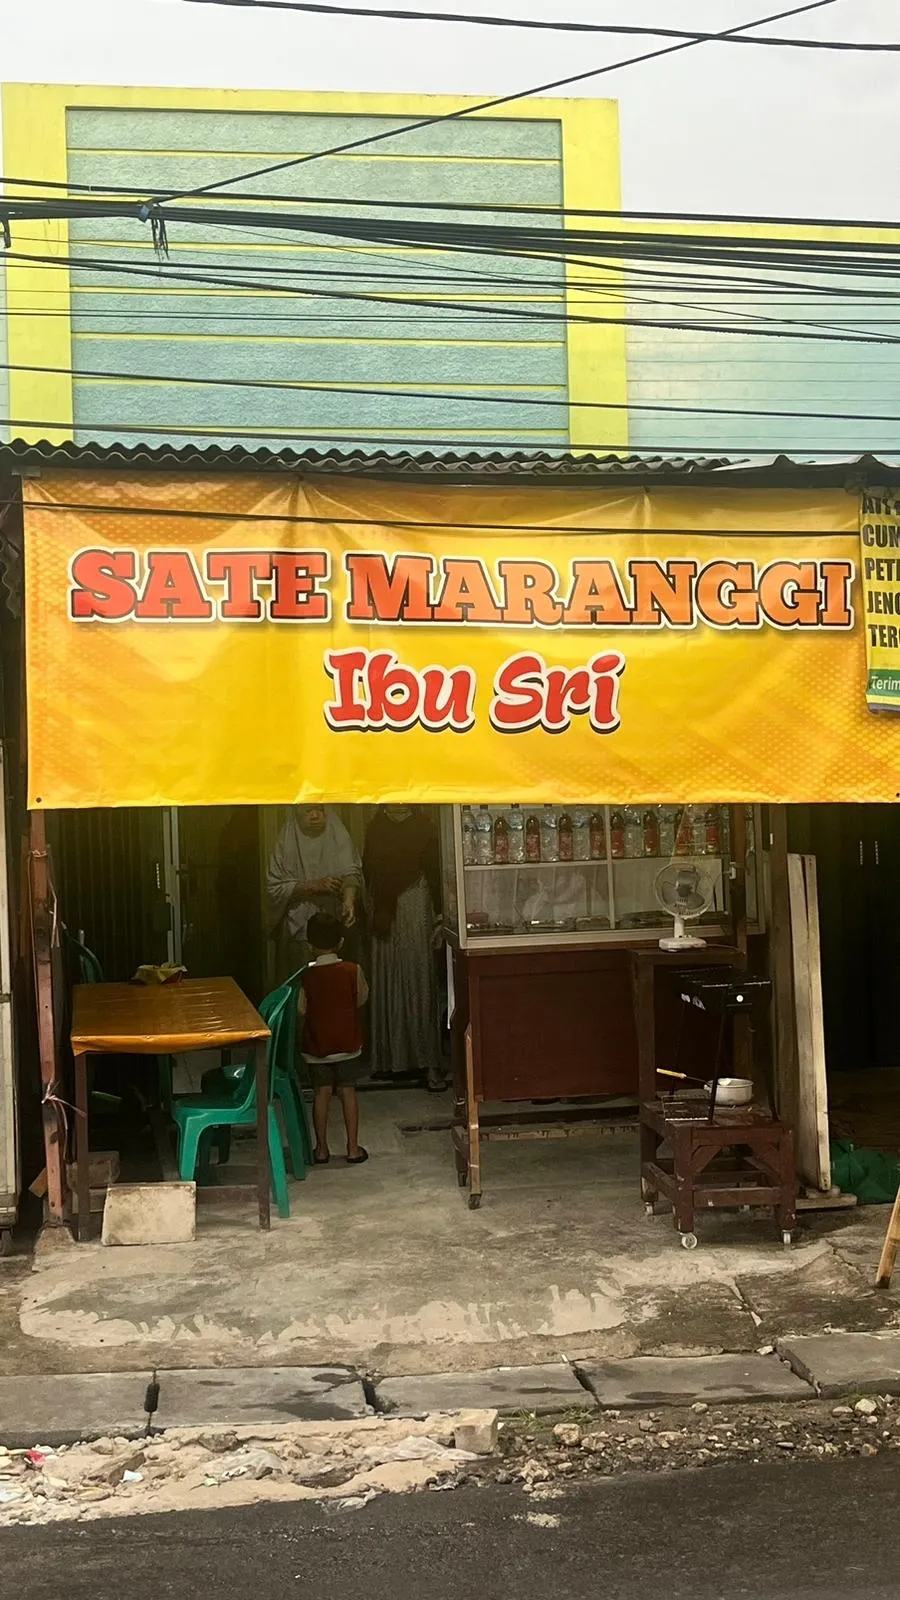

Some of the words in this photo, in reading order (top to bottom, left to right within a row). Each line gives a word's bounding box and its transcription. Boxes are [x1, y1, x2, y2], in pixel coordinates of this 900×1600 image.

[70, 548, 329, 621] SATE
[344, 552, 853, 628] MARANGGI
[867, 624, 900, 648] TER
[325, 650, 473, 726] Ibu
[491, 652, 623, 727] Sri
